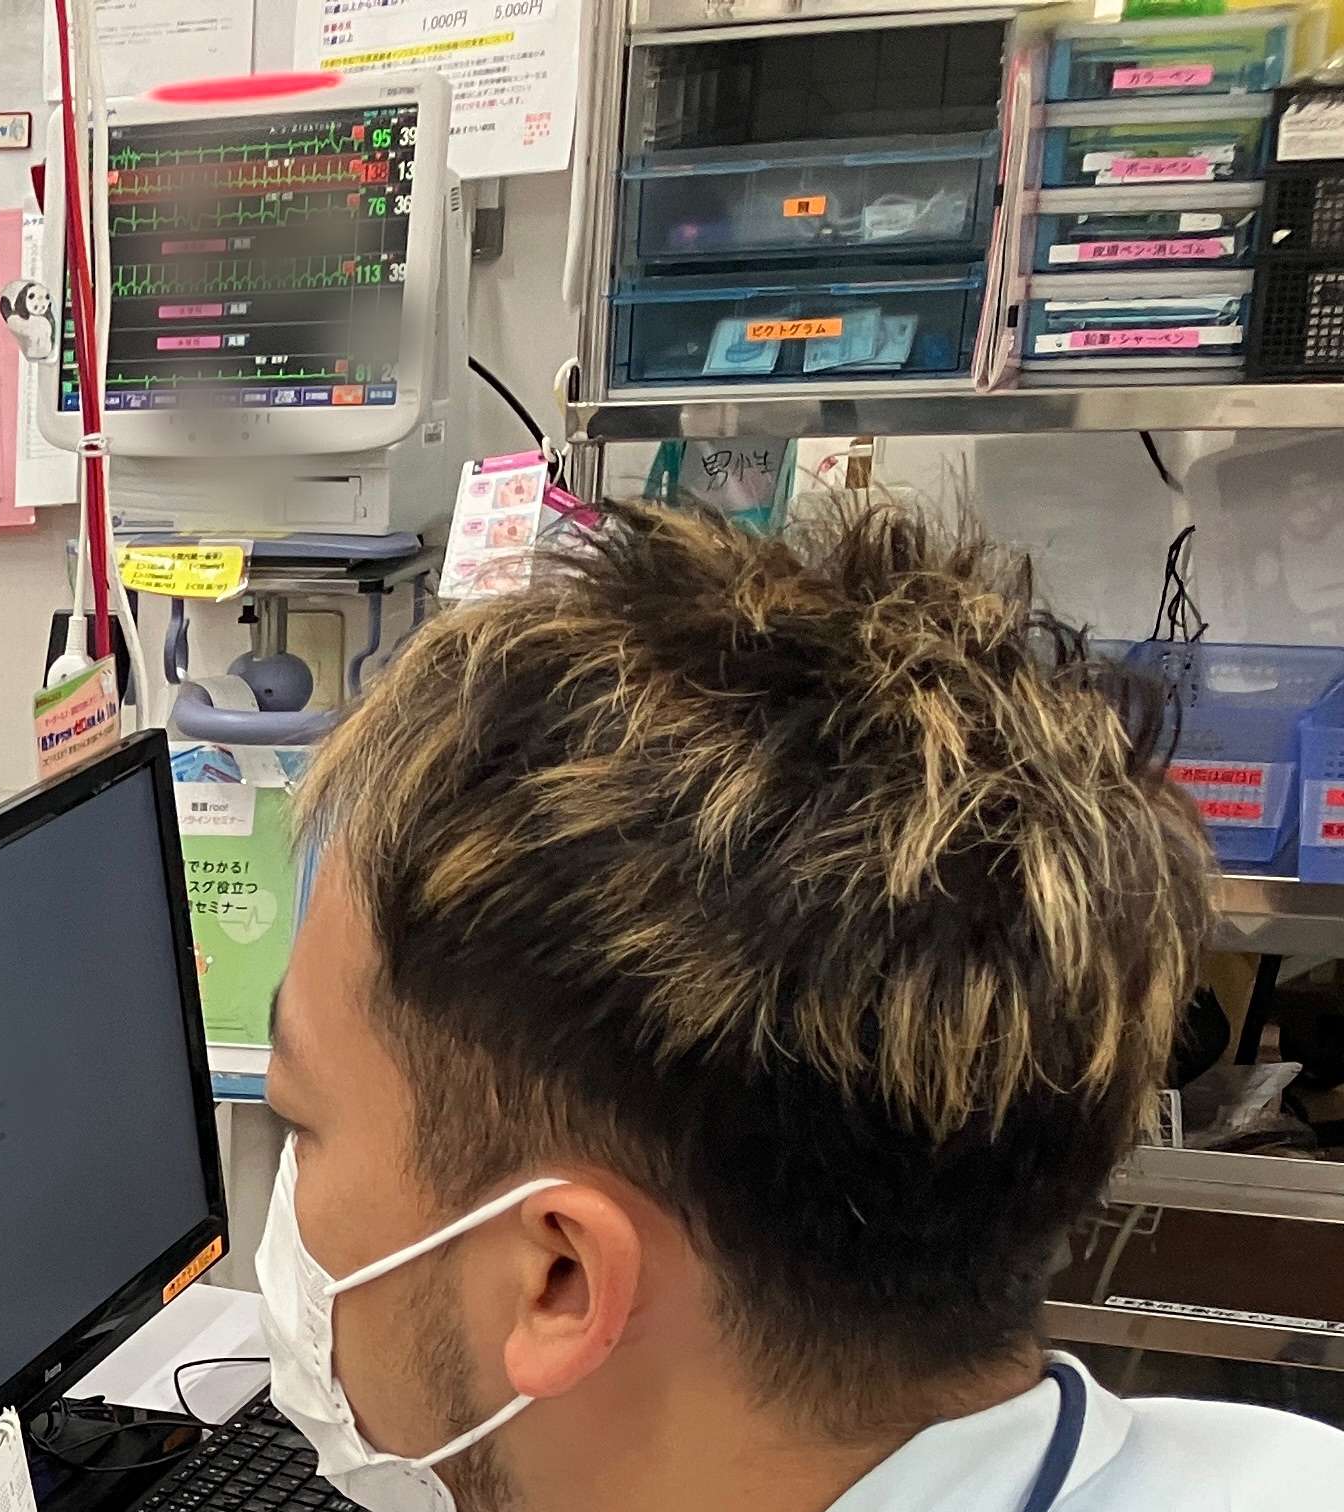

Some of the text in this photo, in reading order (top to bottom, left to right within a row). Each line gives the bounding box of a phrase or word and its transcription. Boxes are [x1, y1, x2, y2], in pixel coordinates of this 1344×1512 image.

[422, 10, 468, 31] 1,000円
[1127, 70, 1197, 85] カラーペン
[372, 126, 418, 149] 95 39
[1124, 161, 1192, 176] ボールペン
[367, 196, 387, 217] 76
[356, 264, 383, 285] 113
[751, 323, 827, 338] ピクトグラム
[188, 880, 259, 896] スグ役立つ
[188, 899, 249, 914] セミナー
